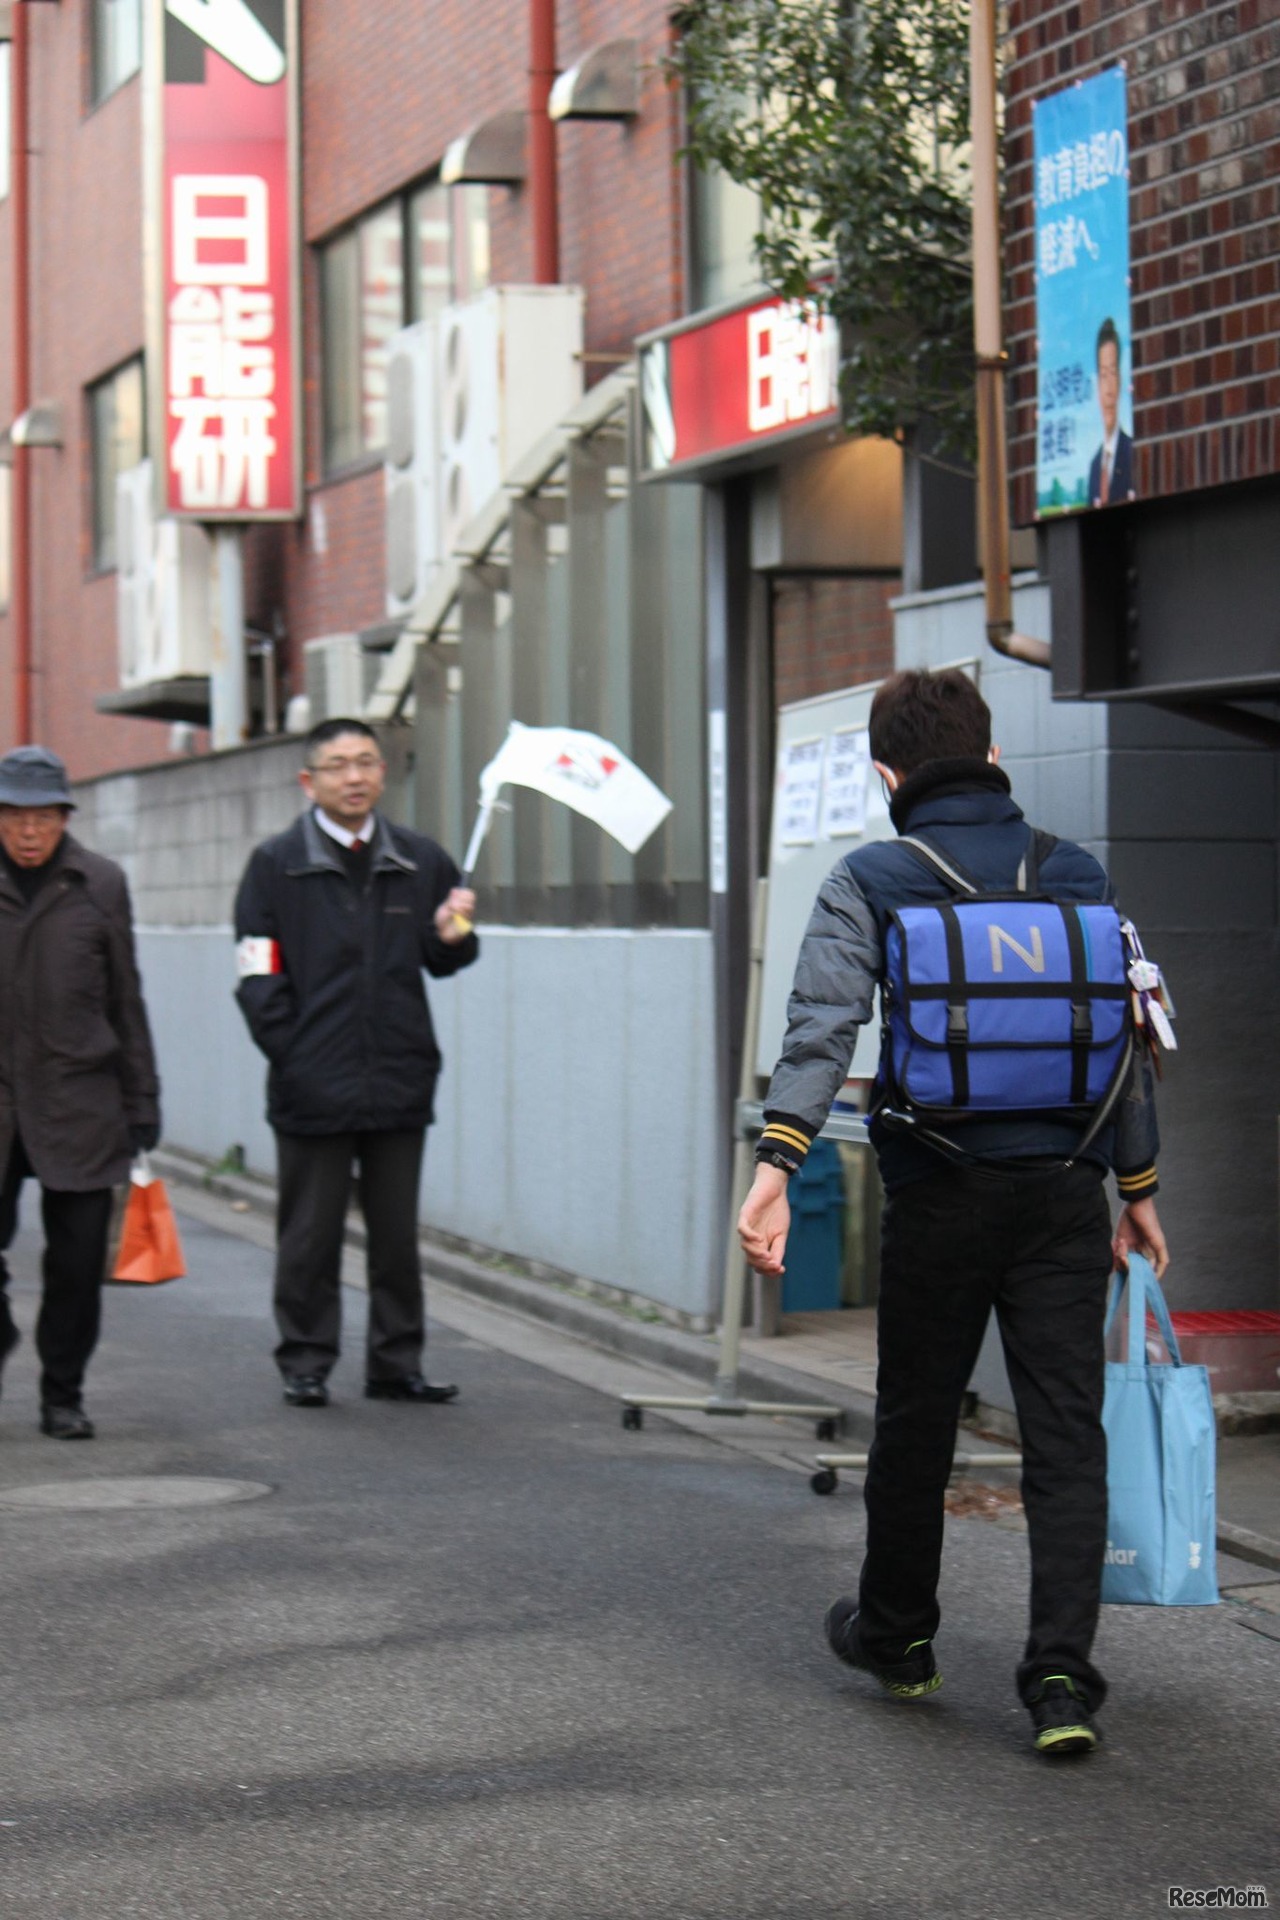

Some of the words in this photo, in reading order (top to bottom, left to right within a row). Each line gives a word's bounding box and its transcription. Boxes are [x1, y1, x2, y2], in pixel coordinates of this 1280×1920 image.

[170, 174, 276, 508] 日能研
[988, 925, 1045, 973] N
